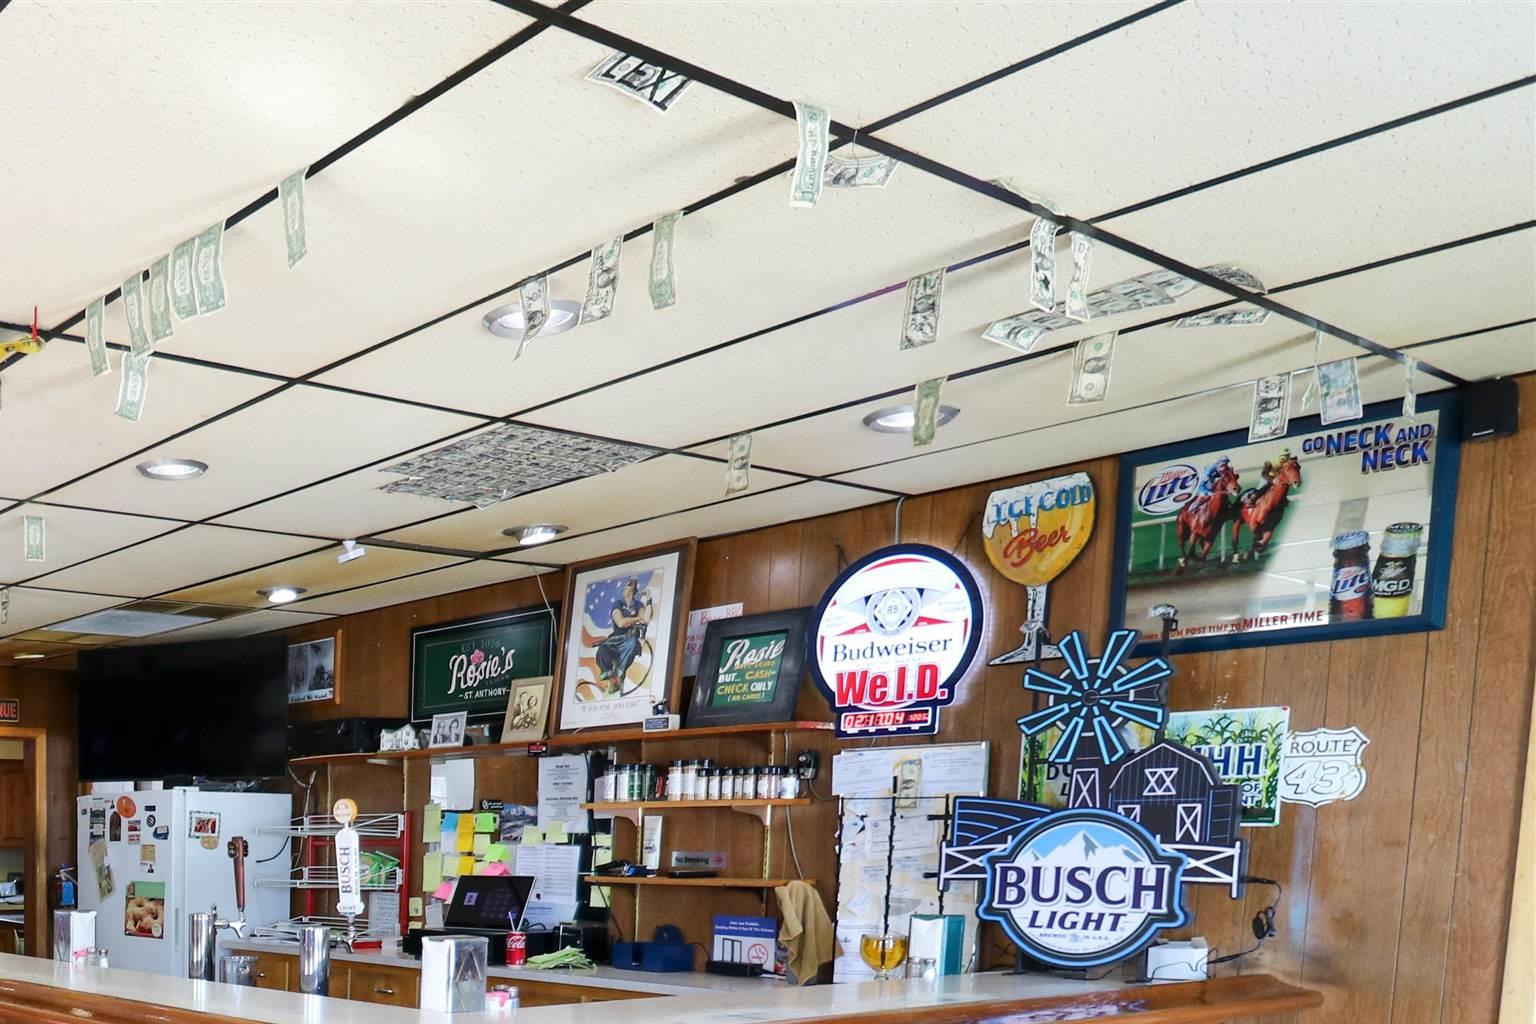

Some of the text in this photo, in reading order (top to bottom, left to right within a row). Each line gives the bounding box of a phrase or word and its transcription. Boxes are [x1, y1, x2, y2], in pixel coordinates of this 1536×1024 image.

[601, 54, 688, 111] LEXI
[1302, 422, 1434, 457] GO NECK AND
[1361, 440, 1432, 475] NECK
[992, 485, 1092, 523] ICE COLD
[1003, 525, 1071, 568] Beer
[1373, 579, 1410, 592] MGD
[1185, 626, 1206, 635] POST
[1207, 624, 1227, 633] TIME
[1242, 615, 1287, 629] MILLER
[1291, 610, 1324, 622] TIME
[719, 639, 785, 673] Rosie
[832, 635, 952, 662] Budweiser
[447, 646, 515, 694] Rosie's
[717, 680, 773, 695] CHECK ONLY
[835, 664, 947, 706] We I.D.
[475, 689, 507, 699] ANTHONY
[1290, 740, 1352, 755] ROUTE
[1284, 760, 1351, 797] 43
[339, 847, 352, 894] BUSCH
[675, 855, 710, 865] No Smoking
[996, 865, 1166, 910] BUSCH
[1027, 910, 1127, 932] LIGHT
